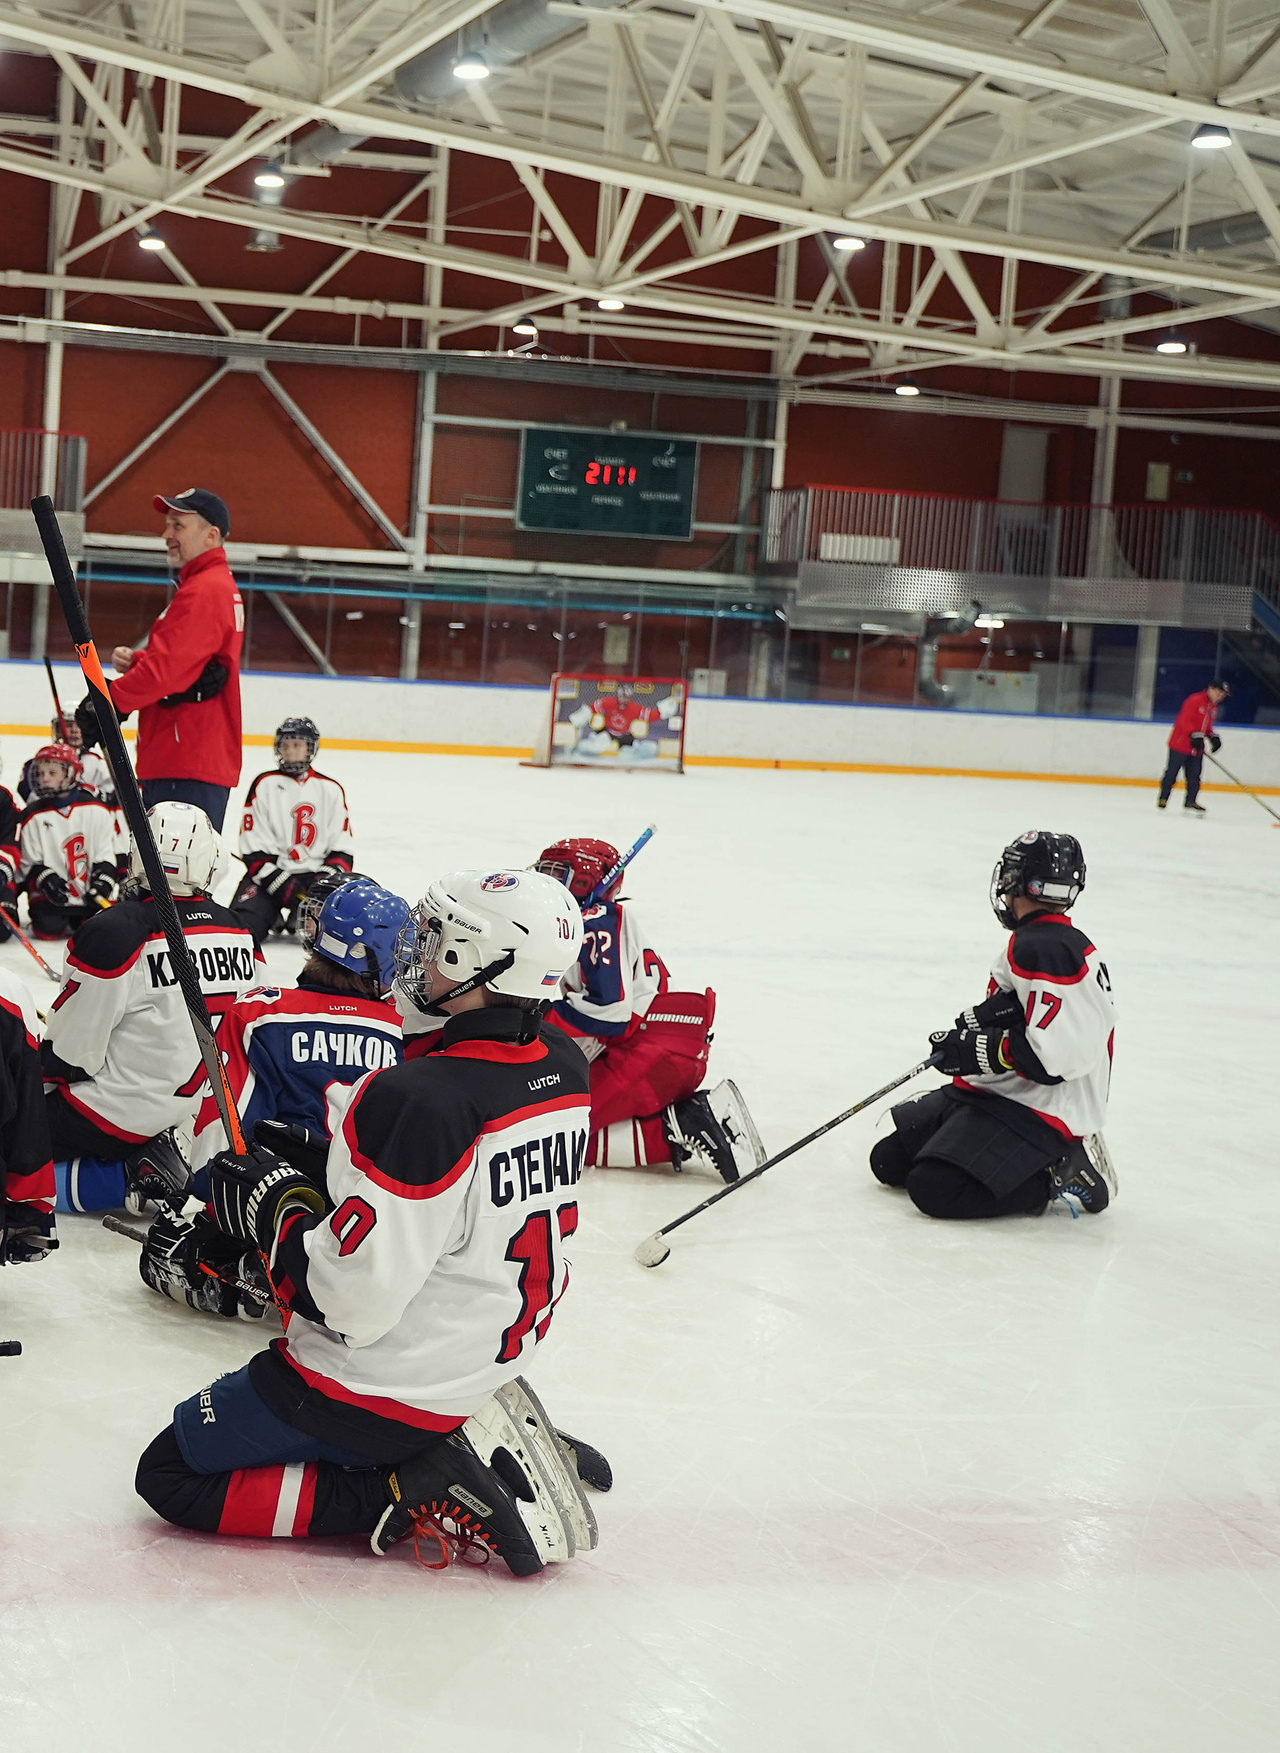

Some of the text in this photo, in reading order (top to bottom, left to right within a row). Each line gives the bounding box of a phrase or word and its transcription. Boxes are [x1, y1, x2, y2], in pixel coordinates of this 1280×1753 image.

[171, 838, 180, 851] 7
[186, 911, 213, 921] LUTCH
[453, 917, 483, 935] BAUER
[556, 917, 570, 940] 10
[449, 980, 475, 998] BAUER
[646, 1013, 703, 1025] WARRIOR
[1026, 990, 1063, 1030] 17
[291, 1030, 398, 1071] САЧКОВ
[528, 1073, 561, 1091] LUTCH
[235, 1279, 270, 1300] BAUER
[200, 1387, 217, 1425] UER
[453, 1486, 488, 1514] BAUER
